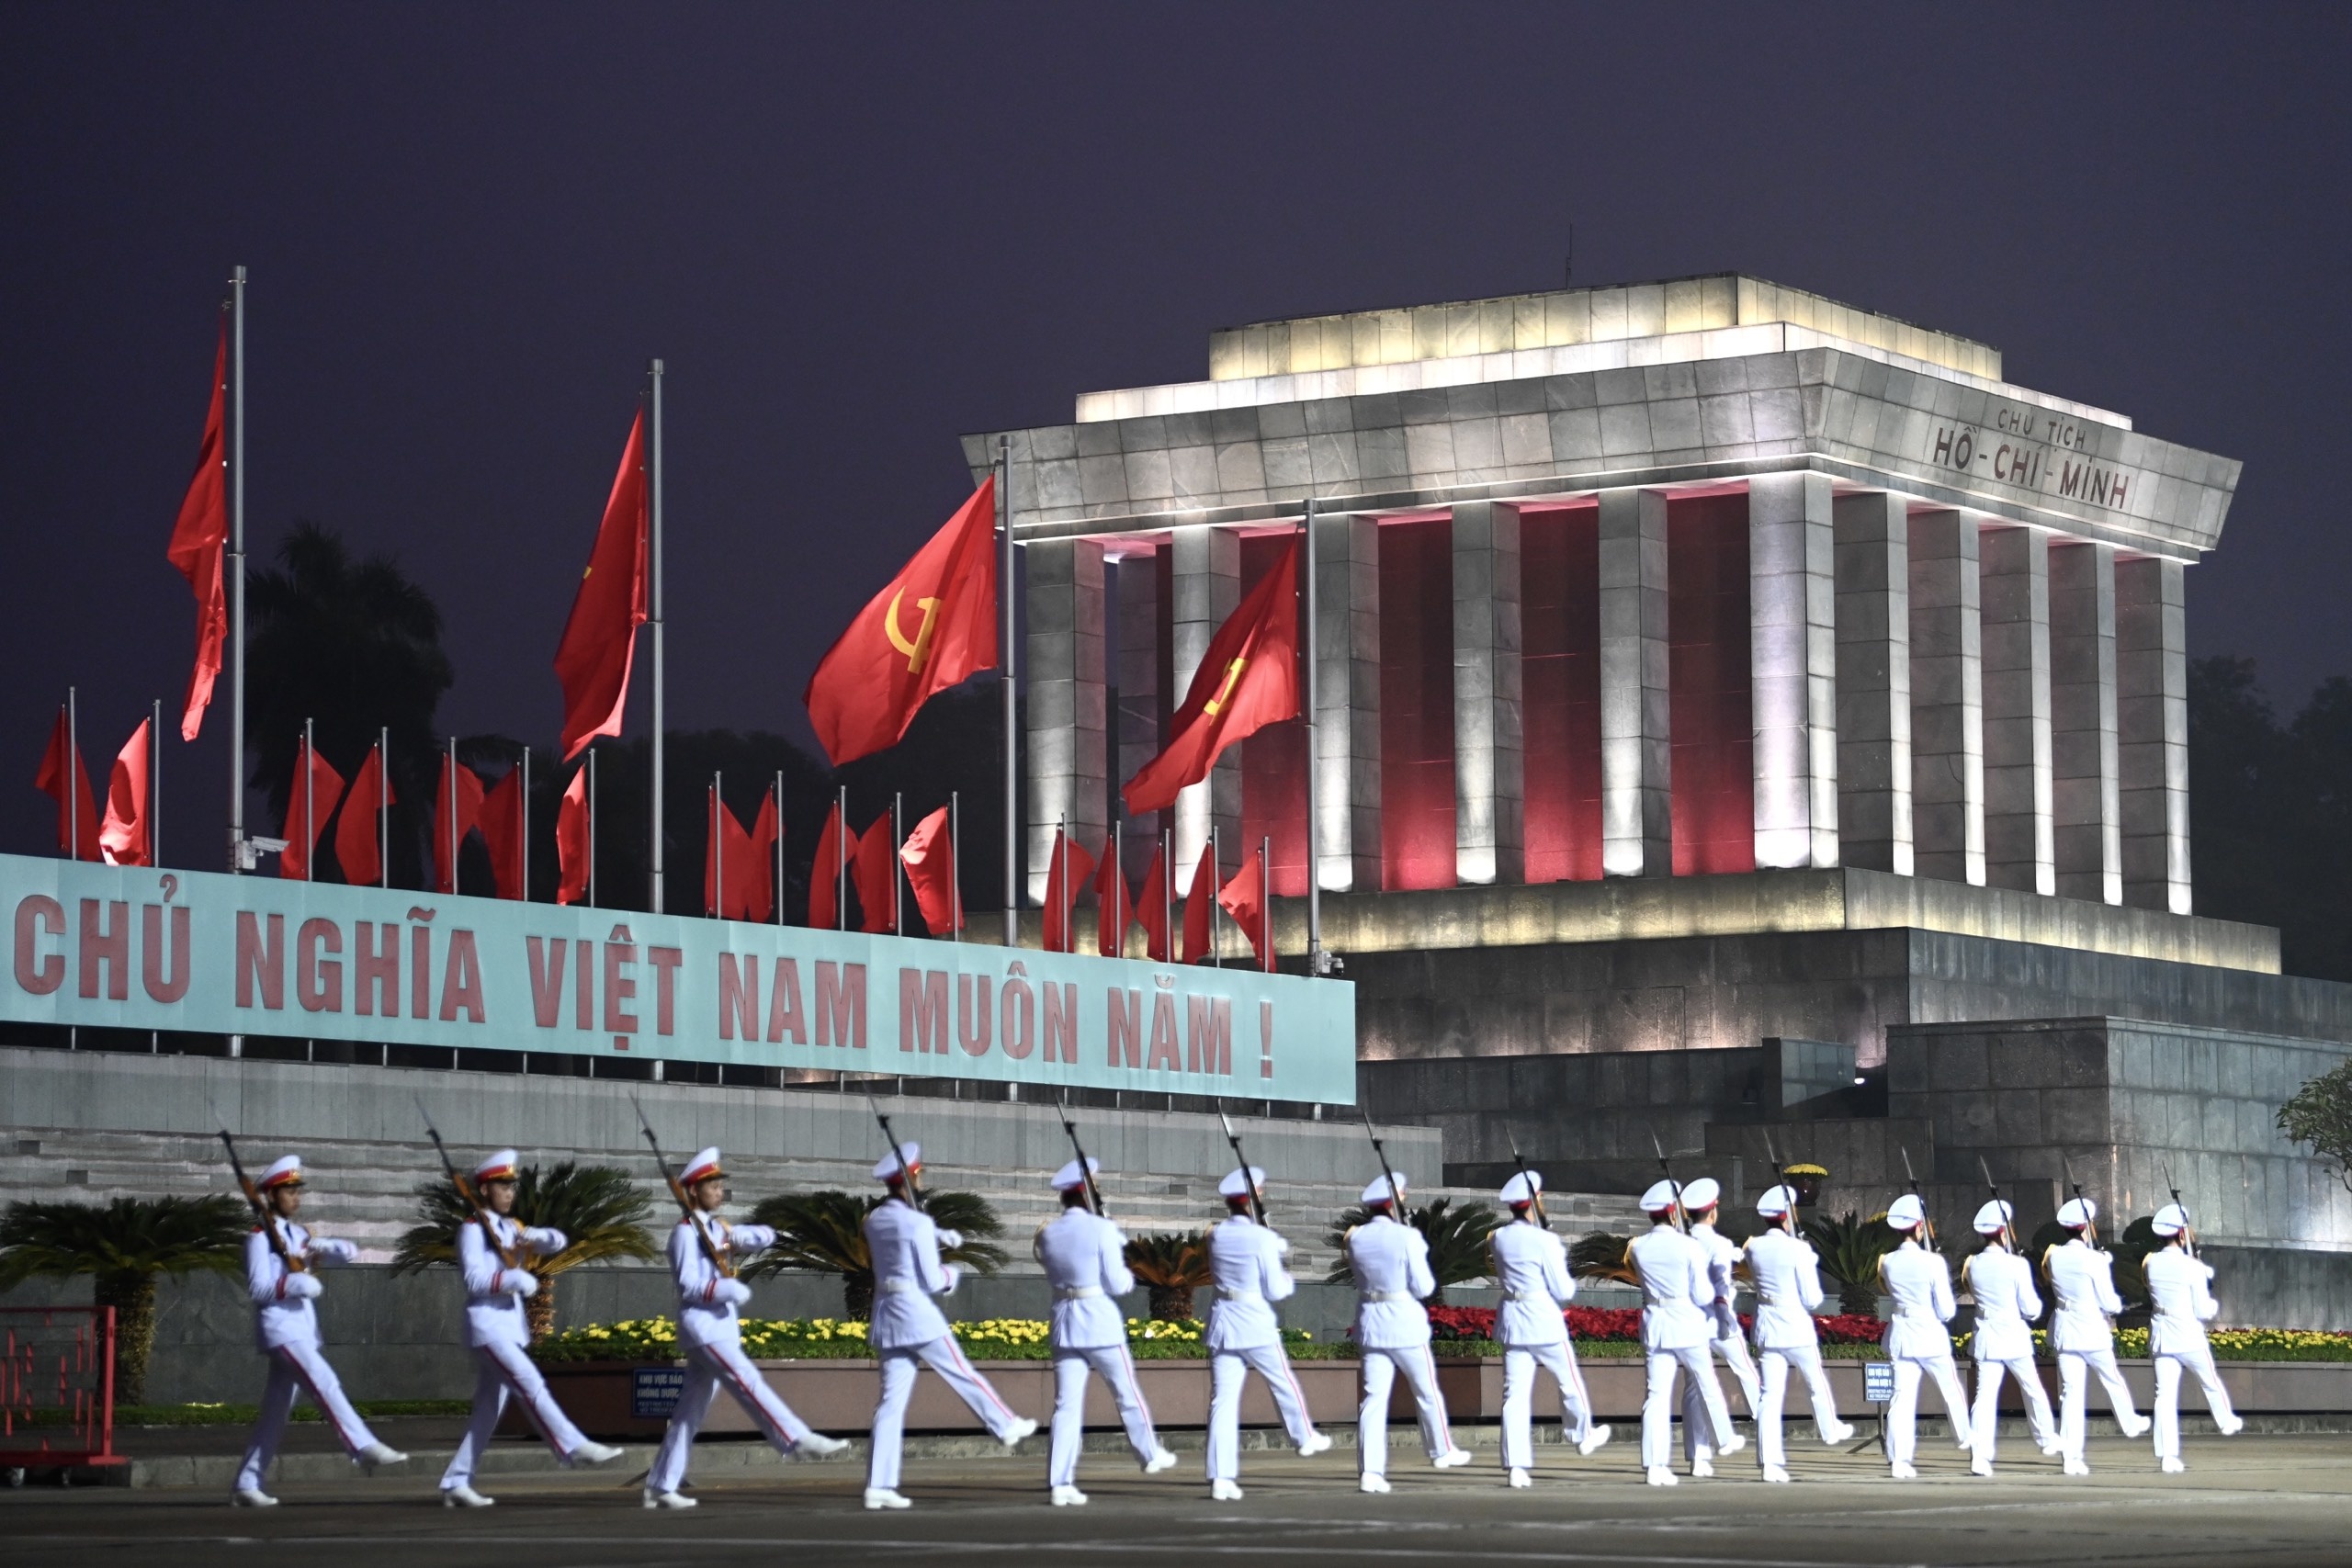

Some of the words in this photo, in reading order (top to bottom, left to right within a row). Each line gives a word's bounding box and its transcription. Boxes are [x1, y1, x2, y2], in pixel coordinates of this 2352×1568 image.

[14, 874, 190, 1003] CHỦ
[234, 906, 486, 1023] NGHĨA
[526, 924, 683, 1050] VIỆT
[718, 952, 867, 1048] NAM
[899, 960, 1077, 1065] MUÔN
[1107, 974, 1232, 1076] NĂM
